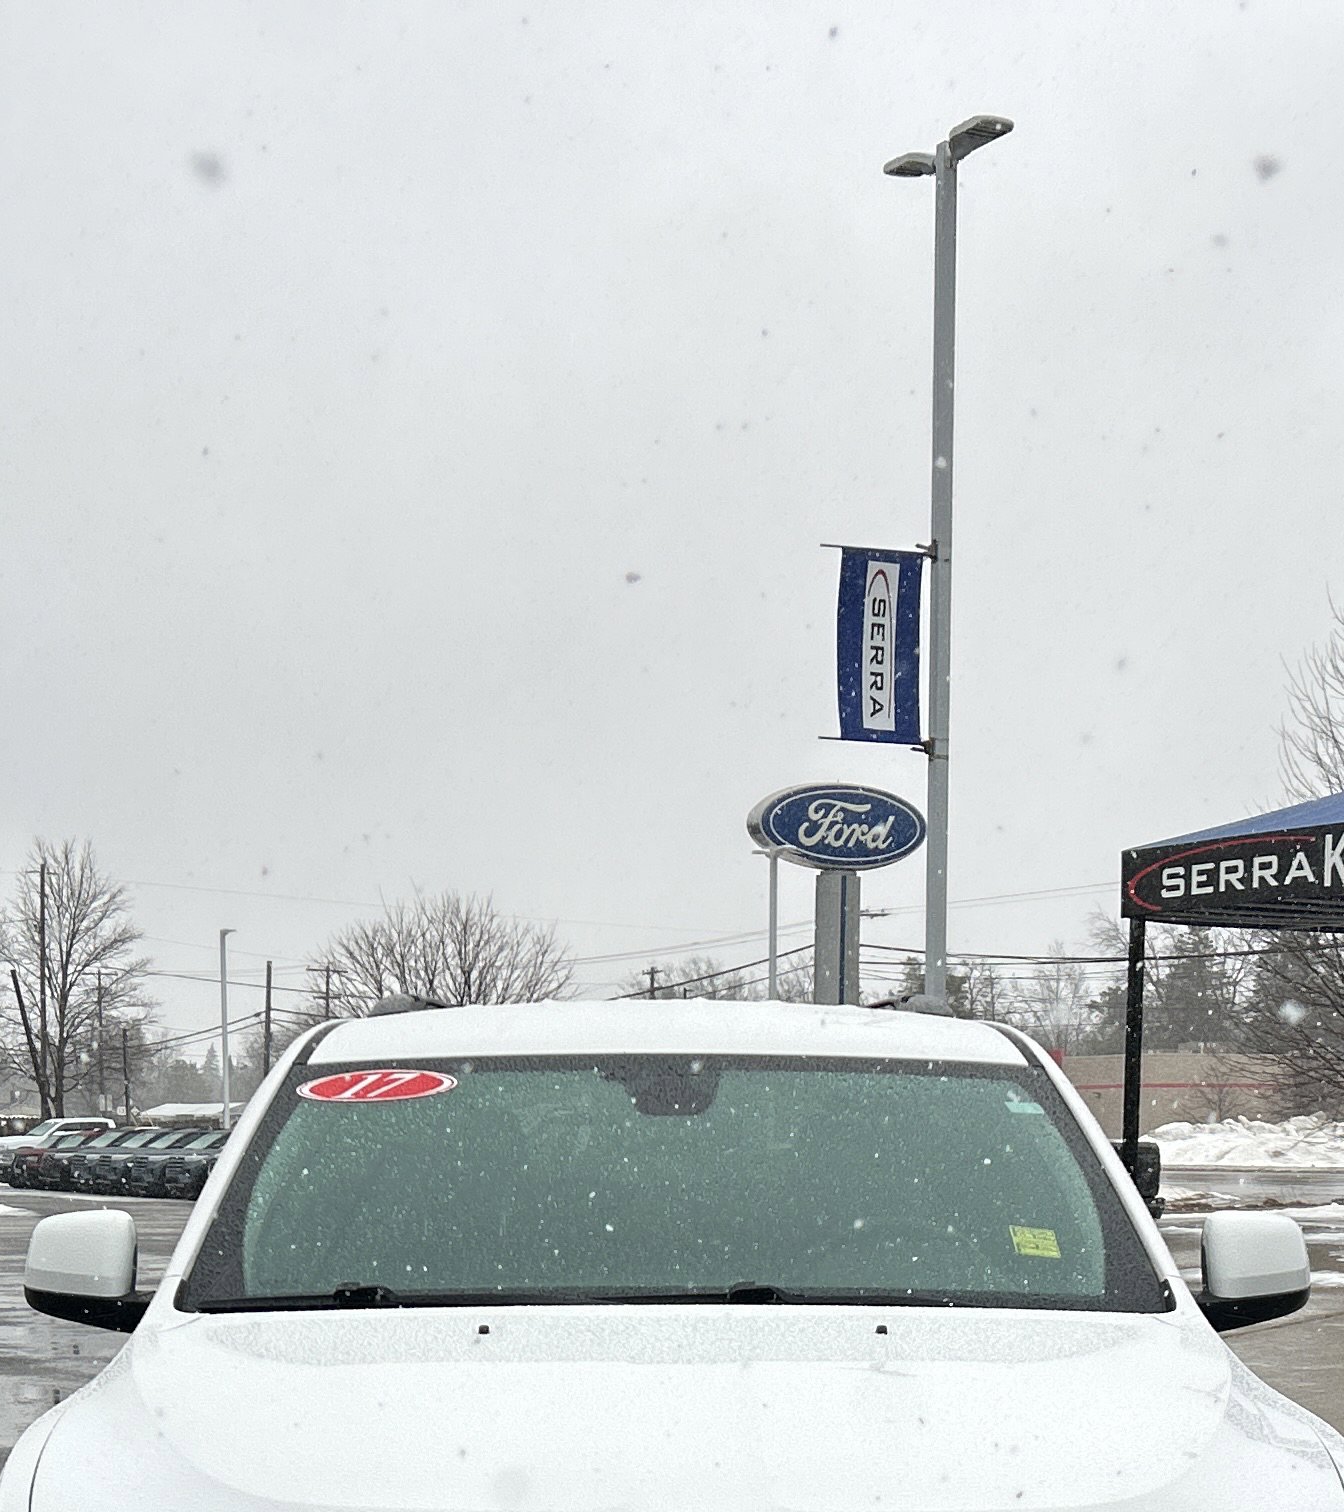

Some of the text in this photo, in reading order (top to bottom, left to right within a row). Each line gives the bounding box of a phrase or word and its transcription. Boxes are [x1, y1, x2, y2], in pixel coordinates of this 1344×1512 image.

[868, 597, 887, 718] SERRA
[798, 799, 895, 850] Ford
[1160, 850, 1316, 899] SERRA
[331, 1073, 421, 1098] 17
